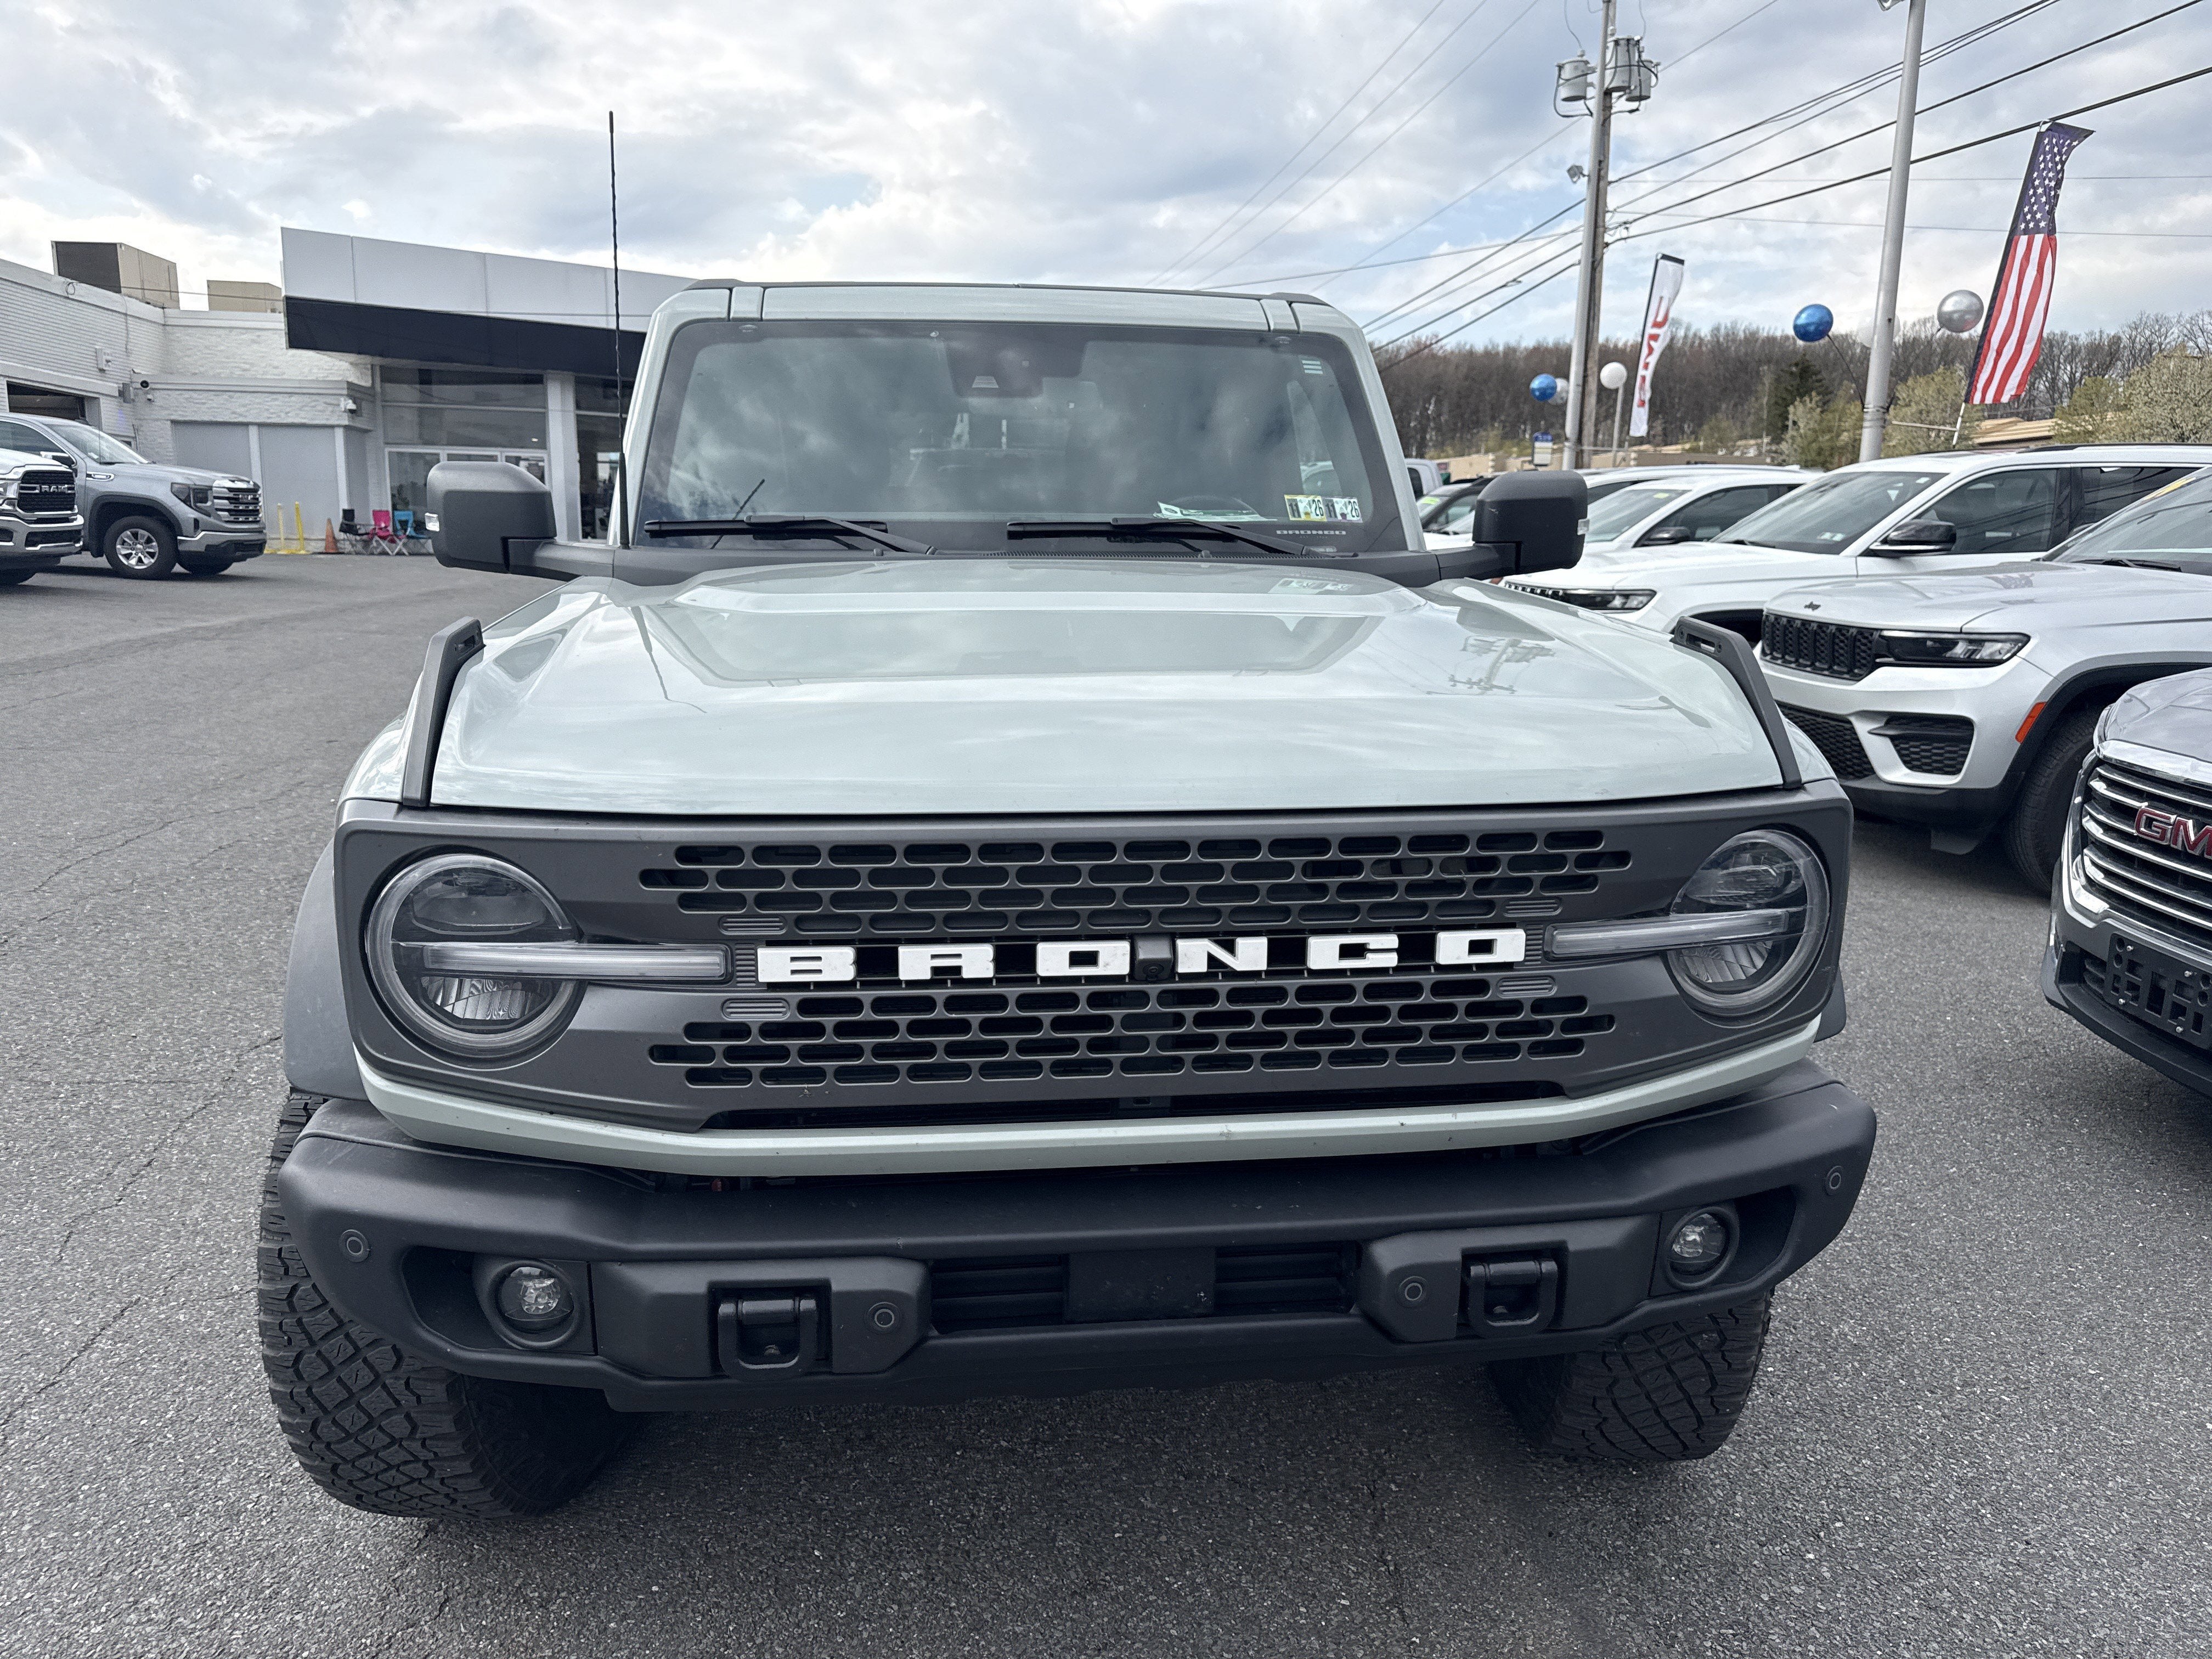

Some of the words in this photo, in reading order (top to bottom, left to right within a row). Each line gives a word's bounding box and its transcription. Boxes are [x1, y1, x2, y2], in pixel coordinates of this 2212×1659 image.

[1289, 502, 1301, 518] 11
[1312, 499, 1324, 516] 26
[1325, 503, 1338, 518] 11
[1348, 500, 1360, 518] 26
[757, 929, 1526, 983] BRONCO
